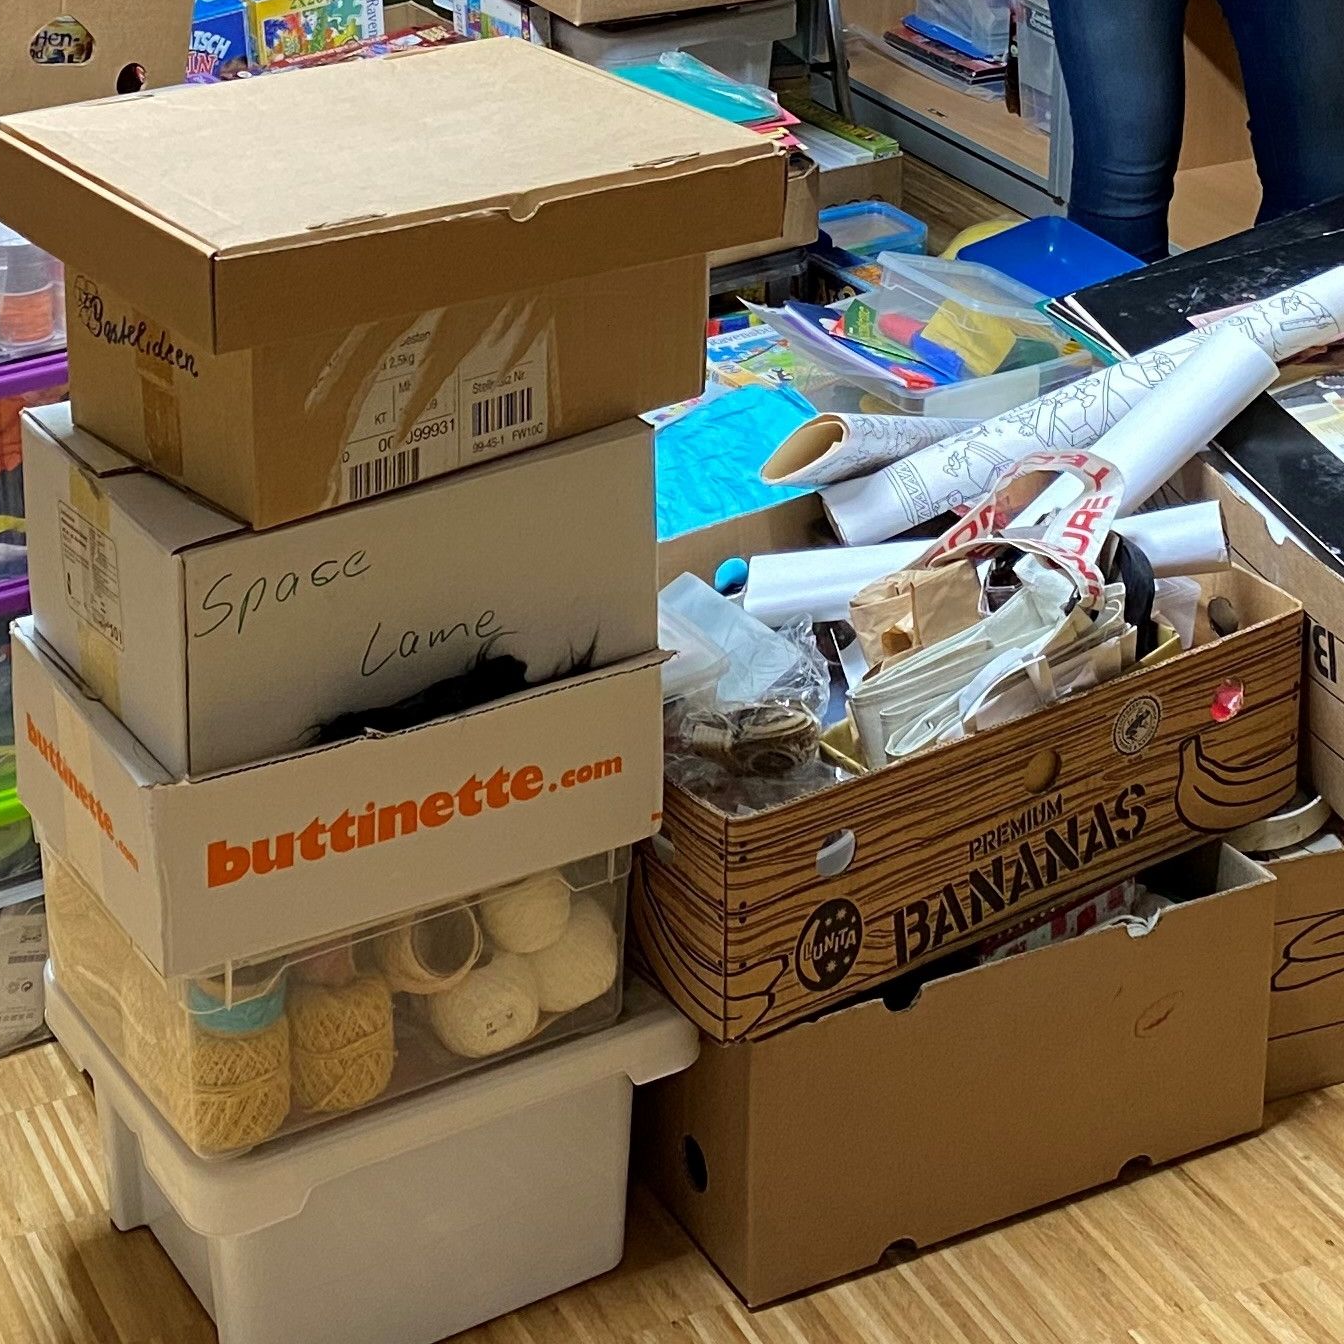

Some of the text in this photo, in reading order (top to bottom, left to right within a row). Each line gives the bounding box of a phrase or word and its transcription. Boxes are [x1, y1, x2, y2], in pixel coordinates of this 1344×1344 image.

[25, 712, 141, 874] buttinette.com
[206, 754, 624, 889] buttinette.com
[968, 792, 1064, 862] PREMIUM
[892, 782, 1148, 969] BANANAS
[802, 927, 858, 963] LUNITA
